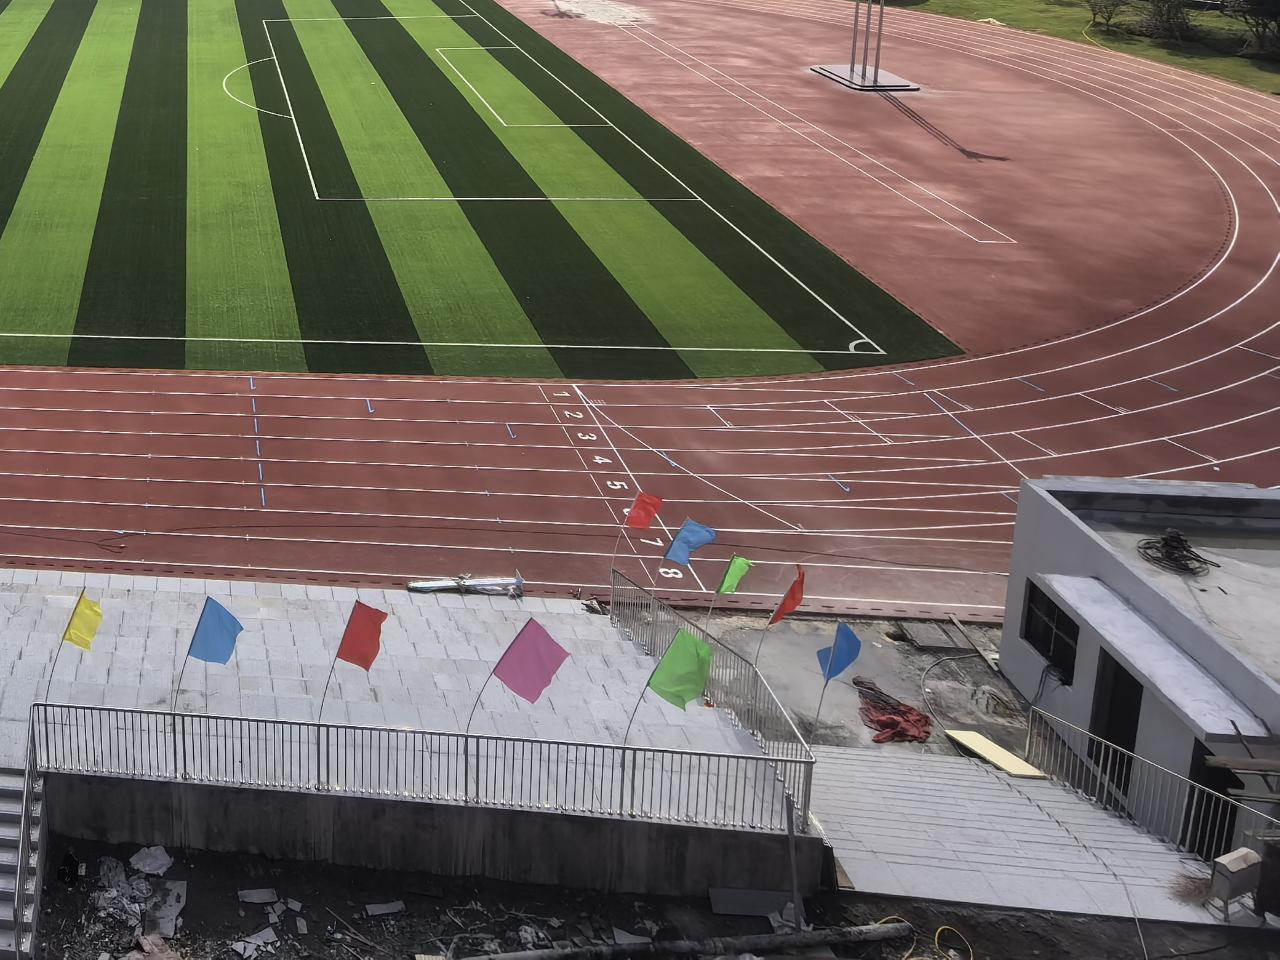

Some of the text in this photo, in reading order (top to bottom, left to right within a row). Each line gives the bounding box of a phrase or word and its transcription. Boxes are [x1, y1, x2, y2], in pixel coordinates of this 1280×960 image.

[564, 410, 584, 419] 2
[577, 432, 597, 441] 3
[592, 455, 613, 464] 4
[606, 480, 629, 490] 5
[640, 537, 664, 546] 7
[659, 568, 683, 579] 8
